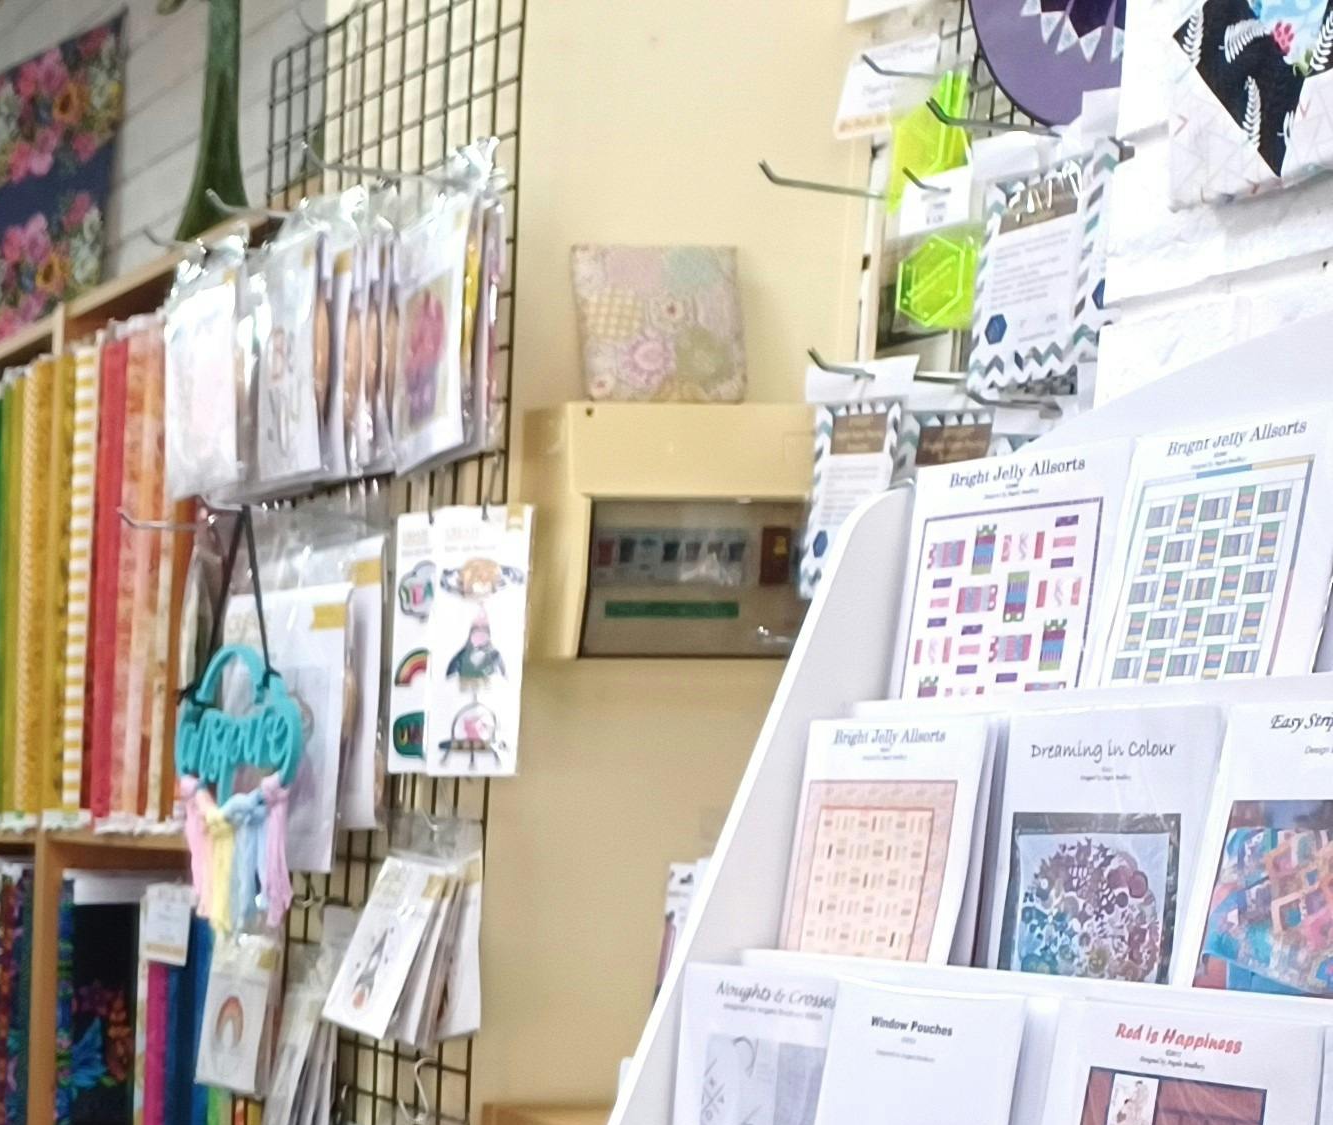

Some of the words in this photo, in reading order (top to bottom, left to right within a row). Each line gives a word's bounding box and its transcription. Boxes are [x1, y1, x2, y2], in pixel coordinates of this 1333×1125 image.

[1213, 430, 1247, 449] Jelly
[1249, 420, 1308, 443] Allsorts
[949, 472, 990, 489] Bright
[993, 464, 1025, 482] Jelly
[1029, 456, 1086, 477] Allsorts
[1270, 714, 1304, 734] Easy
[834, 729, 869, 747] Bright
[871, 729, 899, 746] Jelly
[900, 728, 946, 743] Allsorts
[1031, 740, 1103, 764] Dreaming
[1107, 739, 1124, 757] in
[1128, 739, 1176, 757] Colour
[716, 981, 772, 1003] Noughts
[871, 1016, 908, 1031] Window
[910, 1021, 952, 1037] Pouches
[1115, 1023, 1144, 1041] Red
[1146, 1026, 1159, 1044] is
[1162, 1028, 1243, 1054] Happiness
